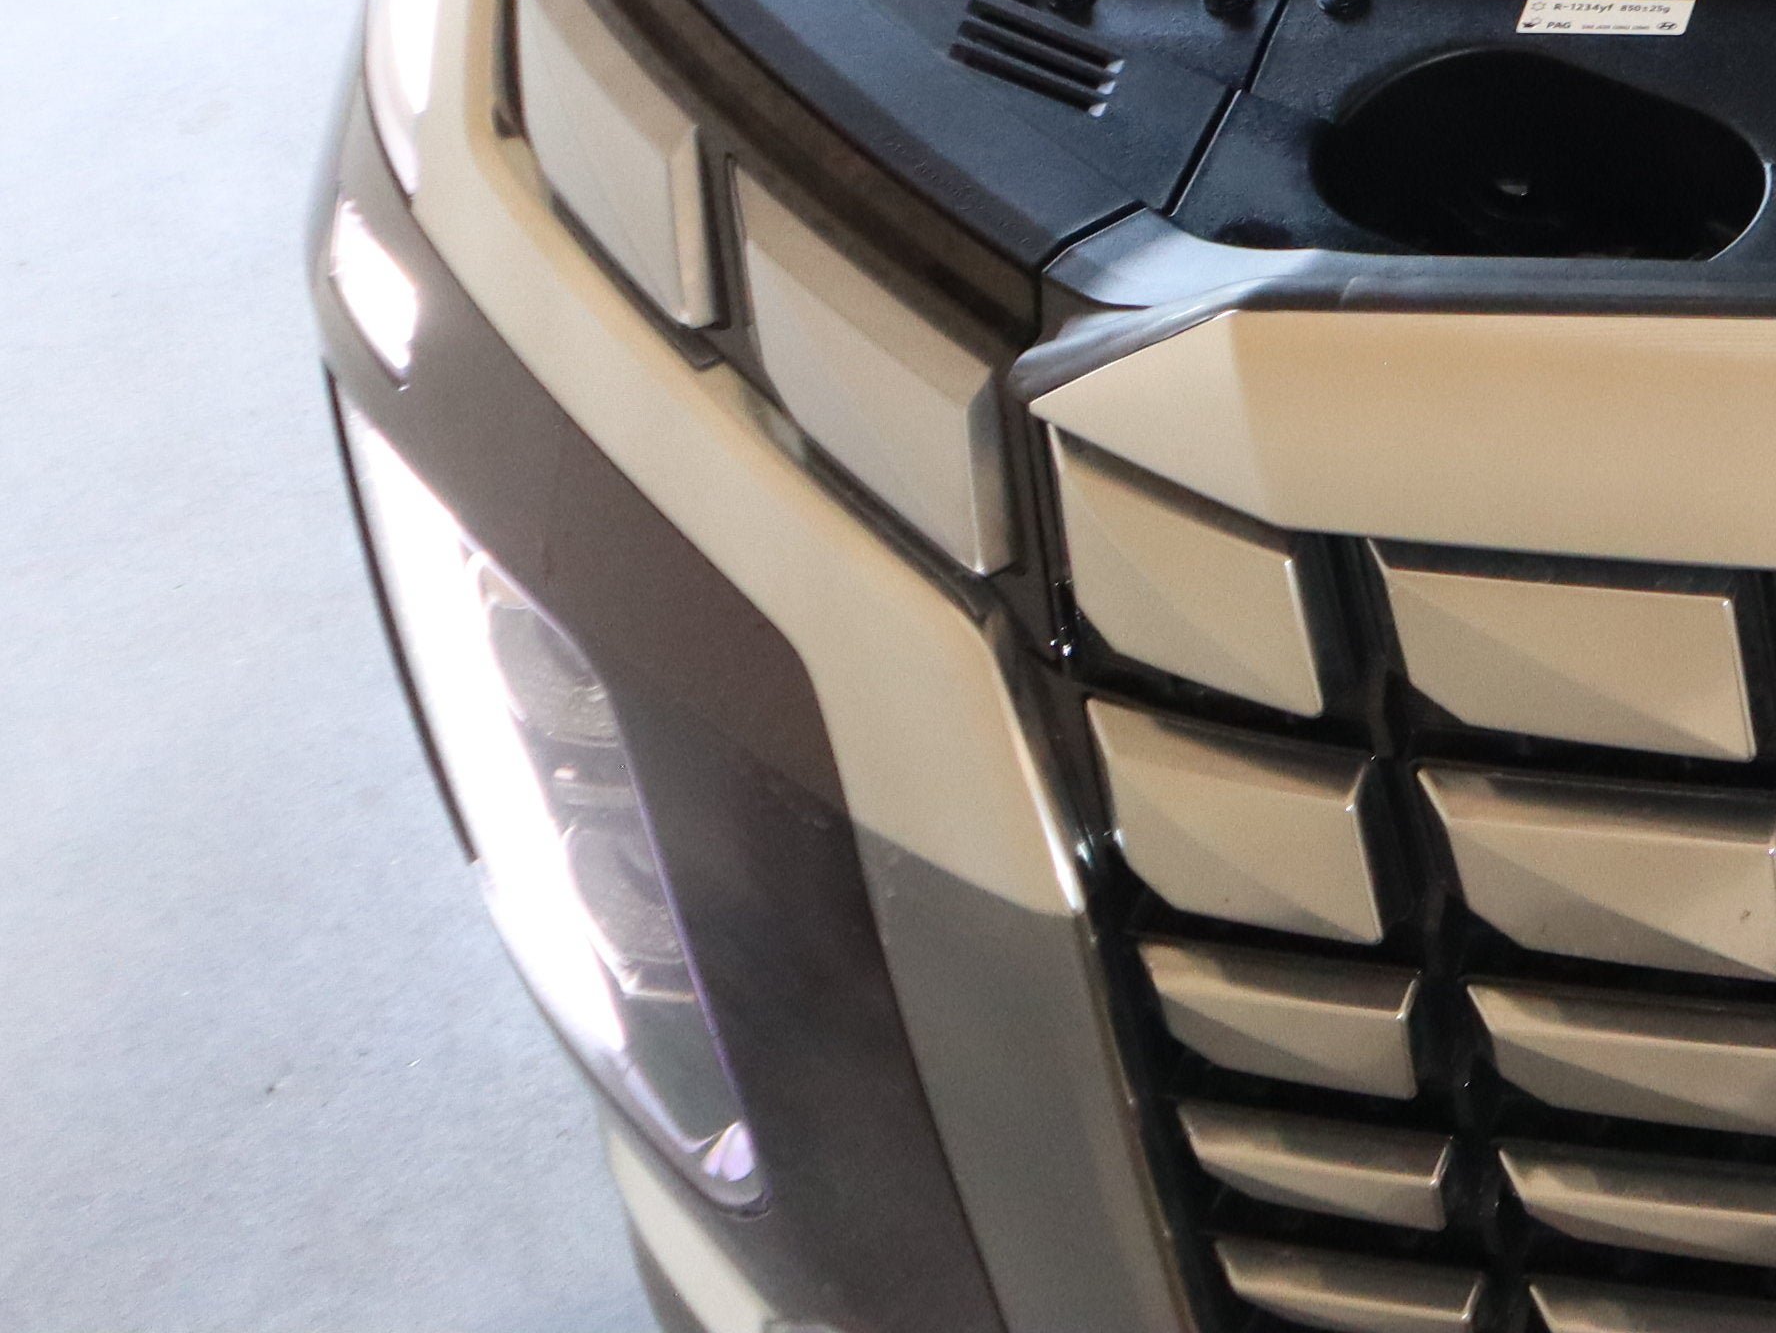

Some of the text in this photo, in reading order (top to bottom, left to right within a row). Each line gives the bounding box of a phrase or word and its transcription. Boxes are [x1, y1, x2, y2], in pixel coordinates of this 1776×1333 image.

[1553, 3, 1671, 14] R-1234yf 850±25g
[1546, 21, 1571, 29] PAG
